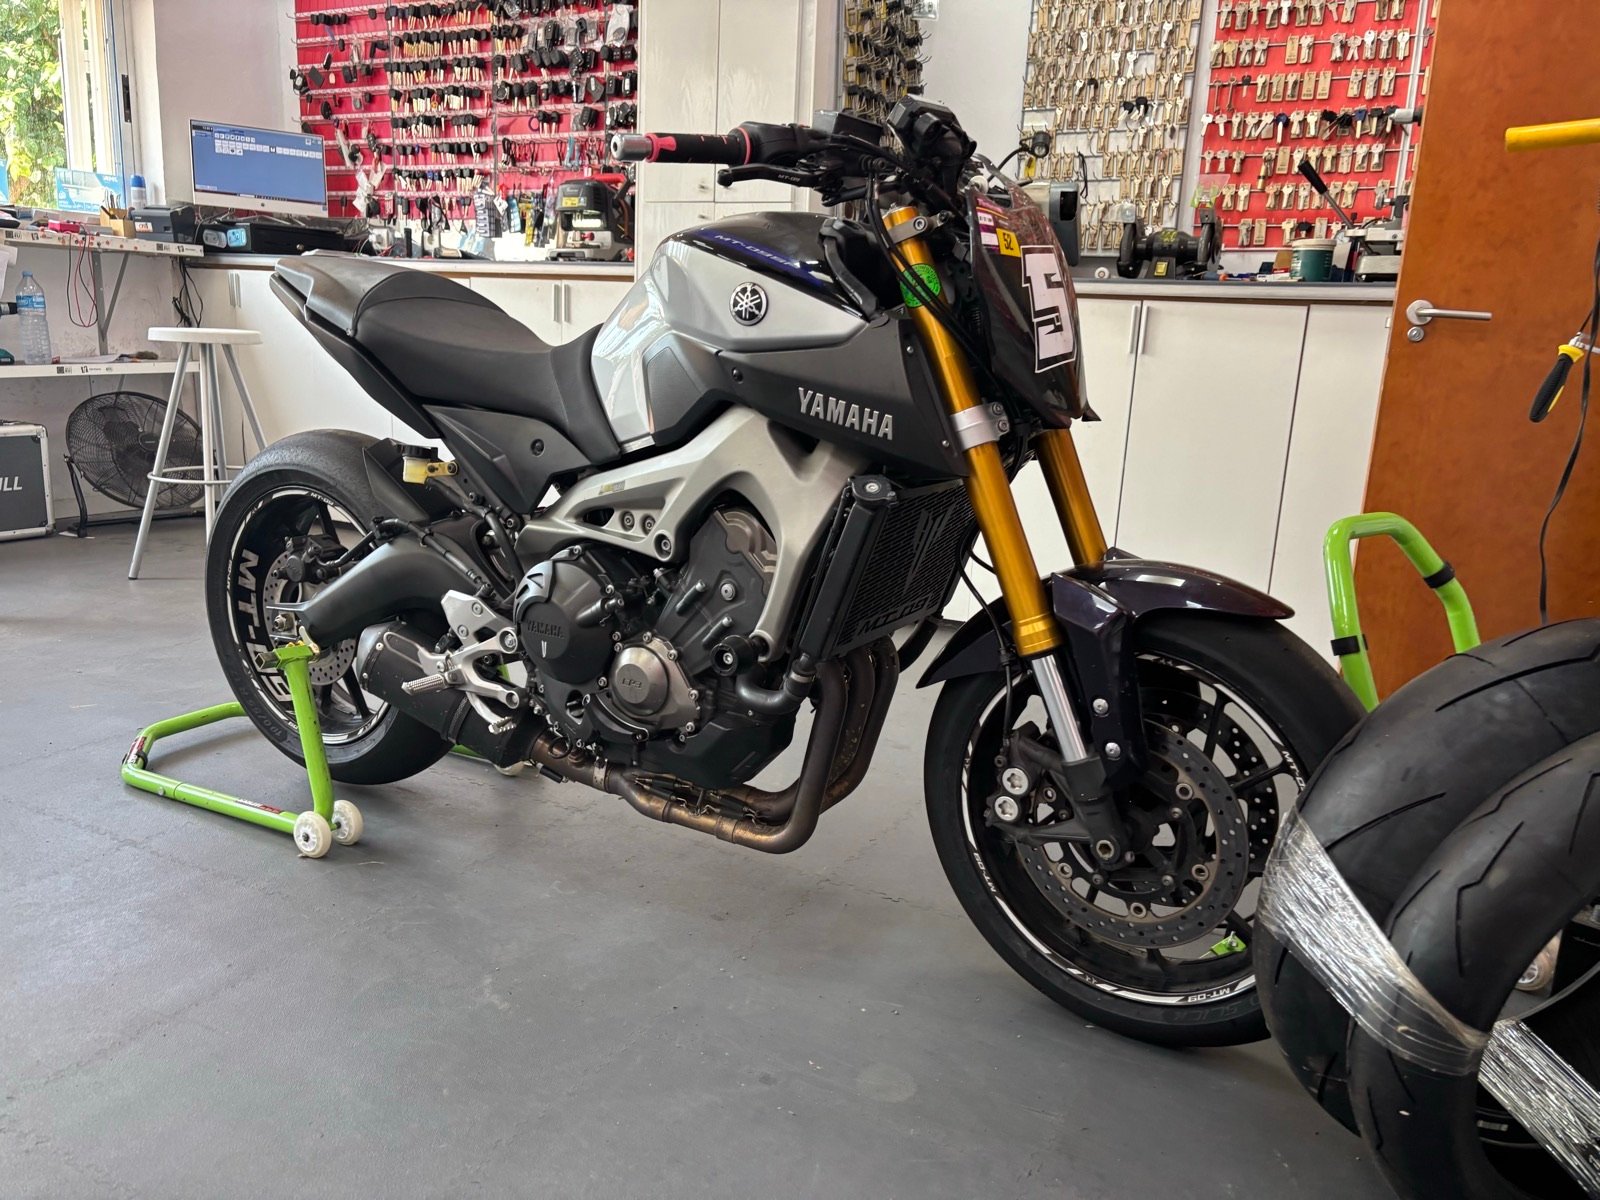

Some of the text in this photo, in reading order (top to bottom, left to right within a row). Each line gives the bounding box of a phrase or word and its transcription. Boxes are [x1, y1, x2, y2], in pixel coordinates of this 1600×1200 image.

[1002, 232, 1014, 251] 52
[798, 386, 895, 441] YAMAHA
[525, 619, 566, 640] YAMAHA
[1281, 750, 1306, 791] MT-0
[973, 852, 997, 893] MT-09
[1187, 987, 1231, 1003] MT-09
